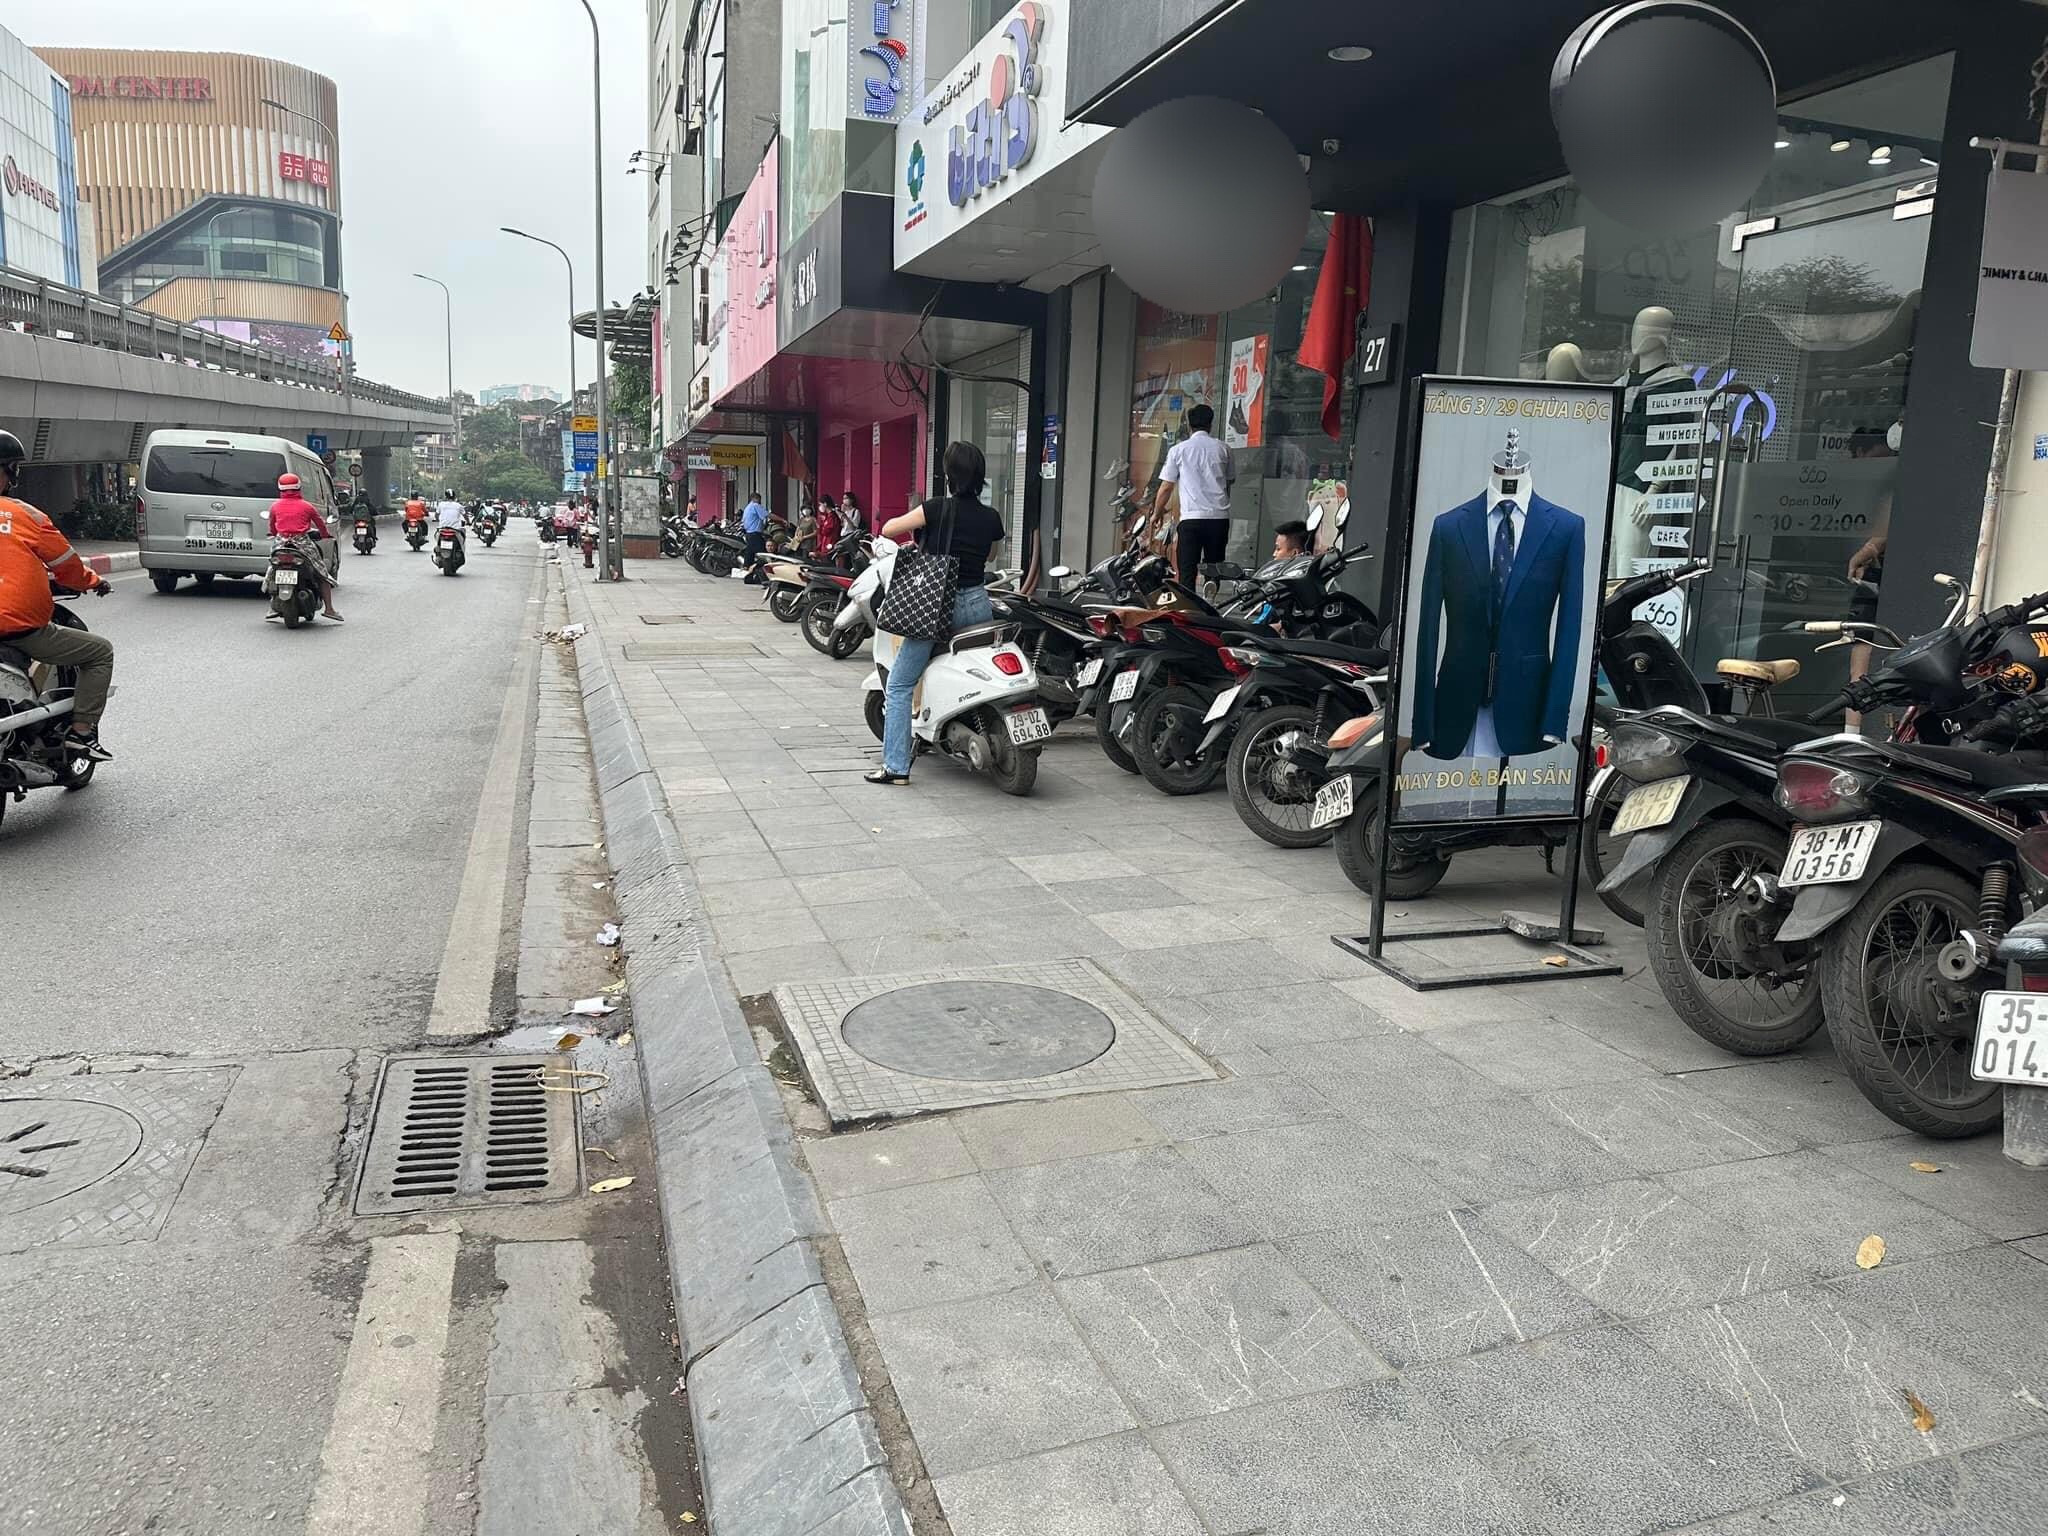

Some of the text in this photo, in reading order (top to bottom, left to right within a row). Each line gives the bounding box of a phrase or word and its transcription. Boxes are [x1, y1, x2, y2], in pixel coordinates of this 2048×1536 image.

[111, 76, 212, 98] CENTER
[312, 162, 327, 175] UNI
[313, 172, 328, 185] QLO
[1982, 267, 2018, 280] JIMMY
[2018, 270, 2026, 281] &
[1364, 336, 1386, 373] 27
[1425, 389, 1472, 414] TẦNG
[1495, 398, 1519, 417] 29
[1520, 396, 1569, 418] CHÙA
[1572, 398, 1611, 424] BỘC
[1652, 400, 1670, 408] FULL
[1673, 399, 1680, 407] OF
[1652, 464, 1698, 477] BAMBO
[1779, 493, 1842, 509] Open Daily
[1810, 513, 1866, 531] 22:00
[184, 538, 206, 549] 29D
[216, 539, 253, 551] 309.68
[1657, 531, 1680, 543] CAFE
[1012, 723, 1050, 743] 694.88
[1394, 771, 1433, 791] MAY
[1436, 770, 1464, 789] ĐO
[1468, 769, 1482, 788] &
[1487, 765, 1528, 786] BÁN
[1801, 826, 1865, 855] 38-M1
[1792, 852, 1855, 882] 0356
